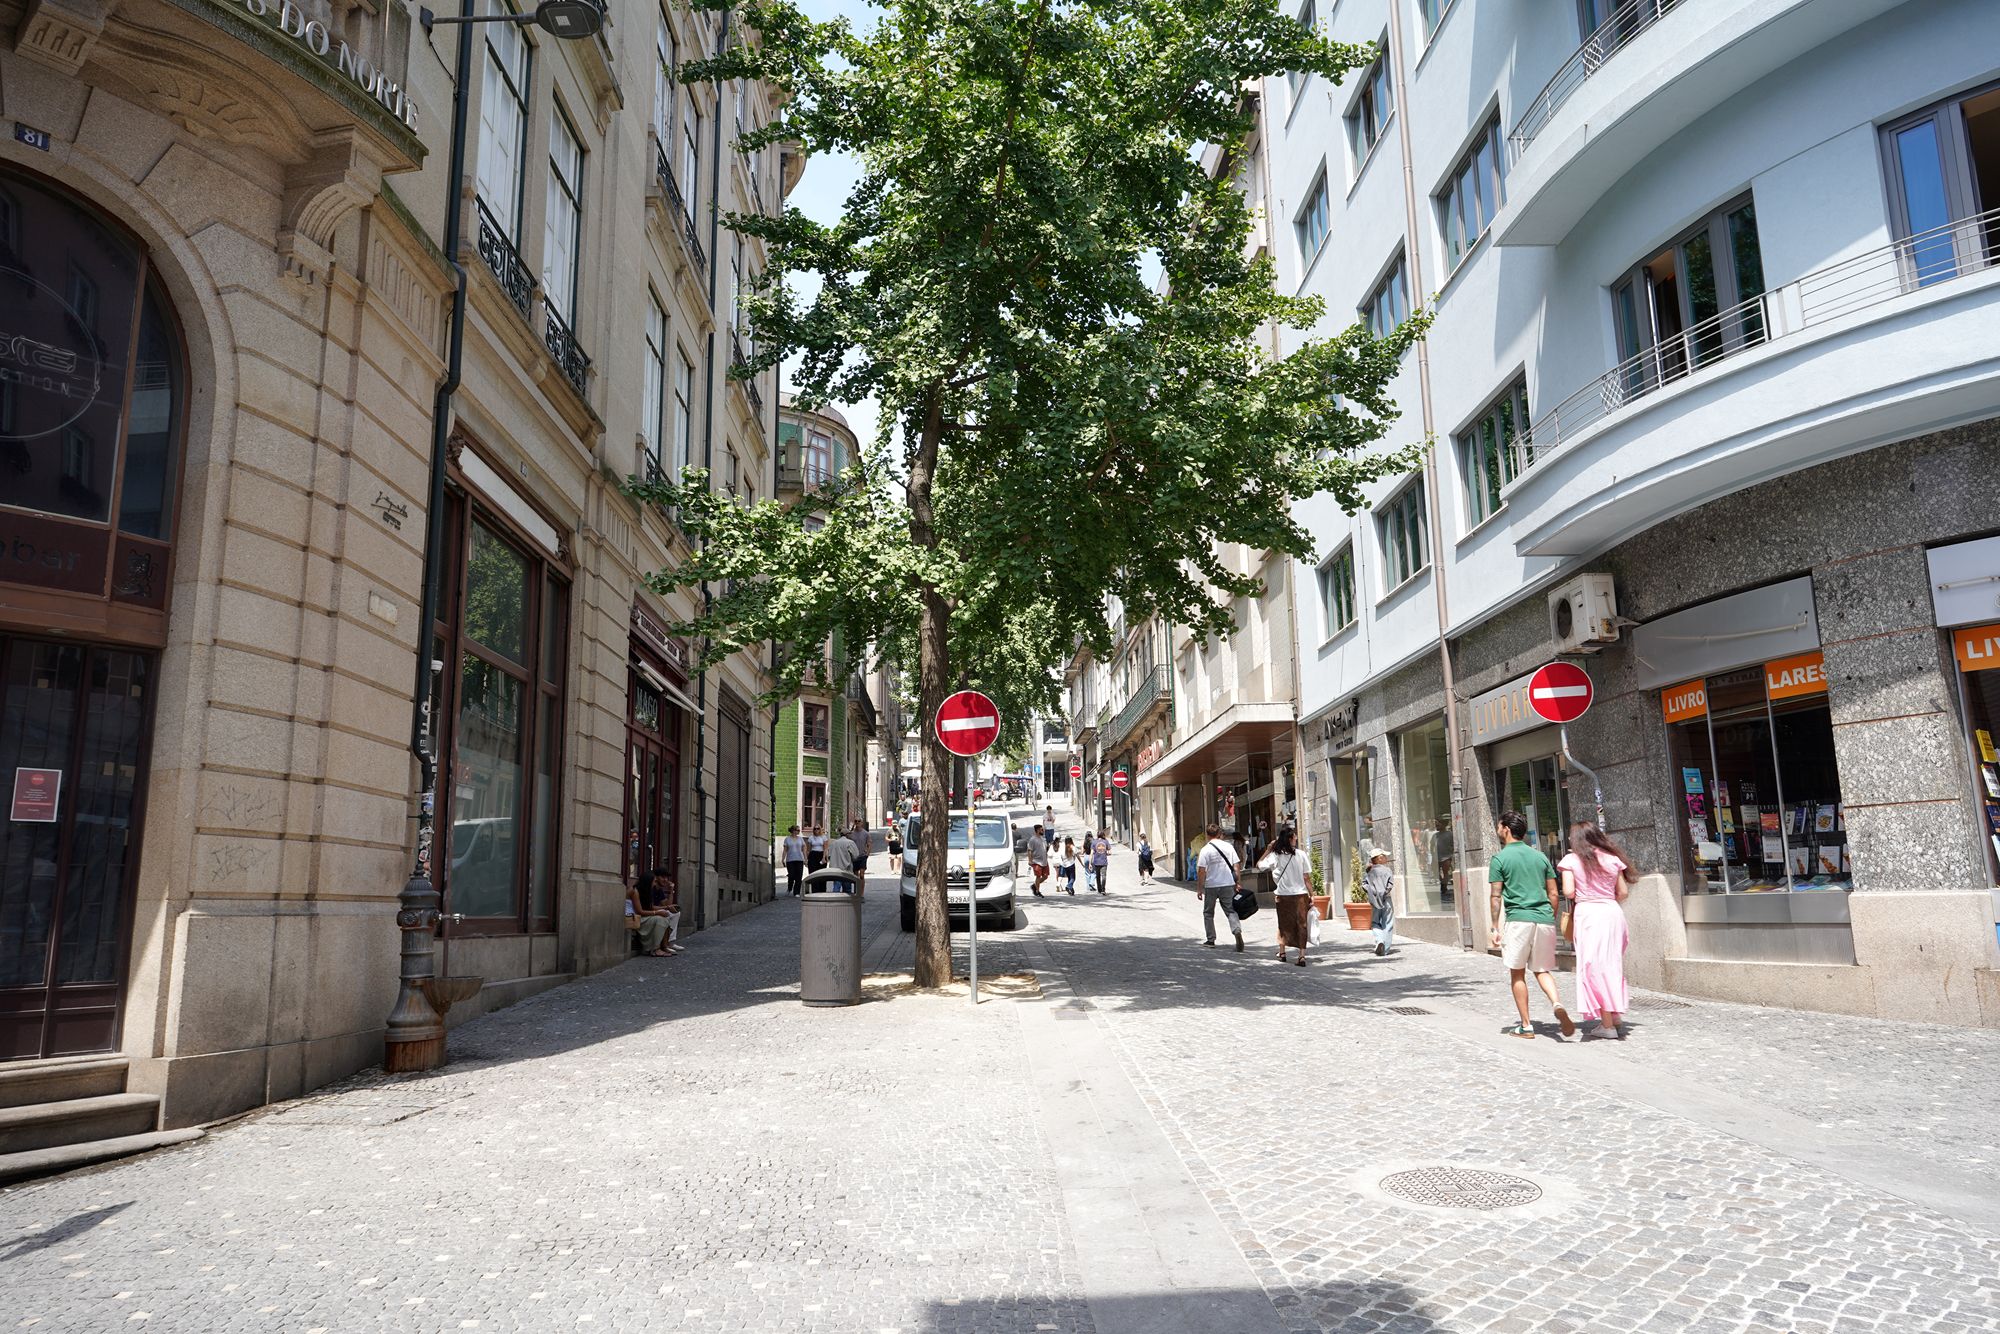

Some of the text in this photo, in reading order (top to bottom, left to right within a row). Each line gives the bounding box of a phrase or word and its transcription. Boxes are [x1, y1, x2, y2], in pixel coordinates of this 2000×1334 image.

[277, 0, 420, 136] DO NORTE
[23, 128, 43, 147] 81
[1668, 689, 1705, 714] LIVRO
